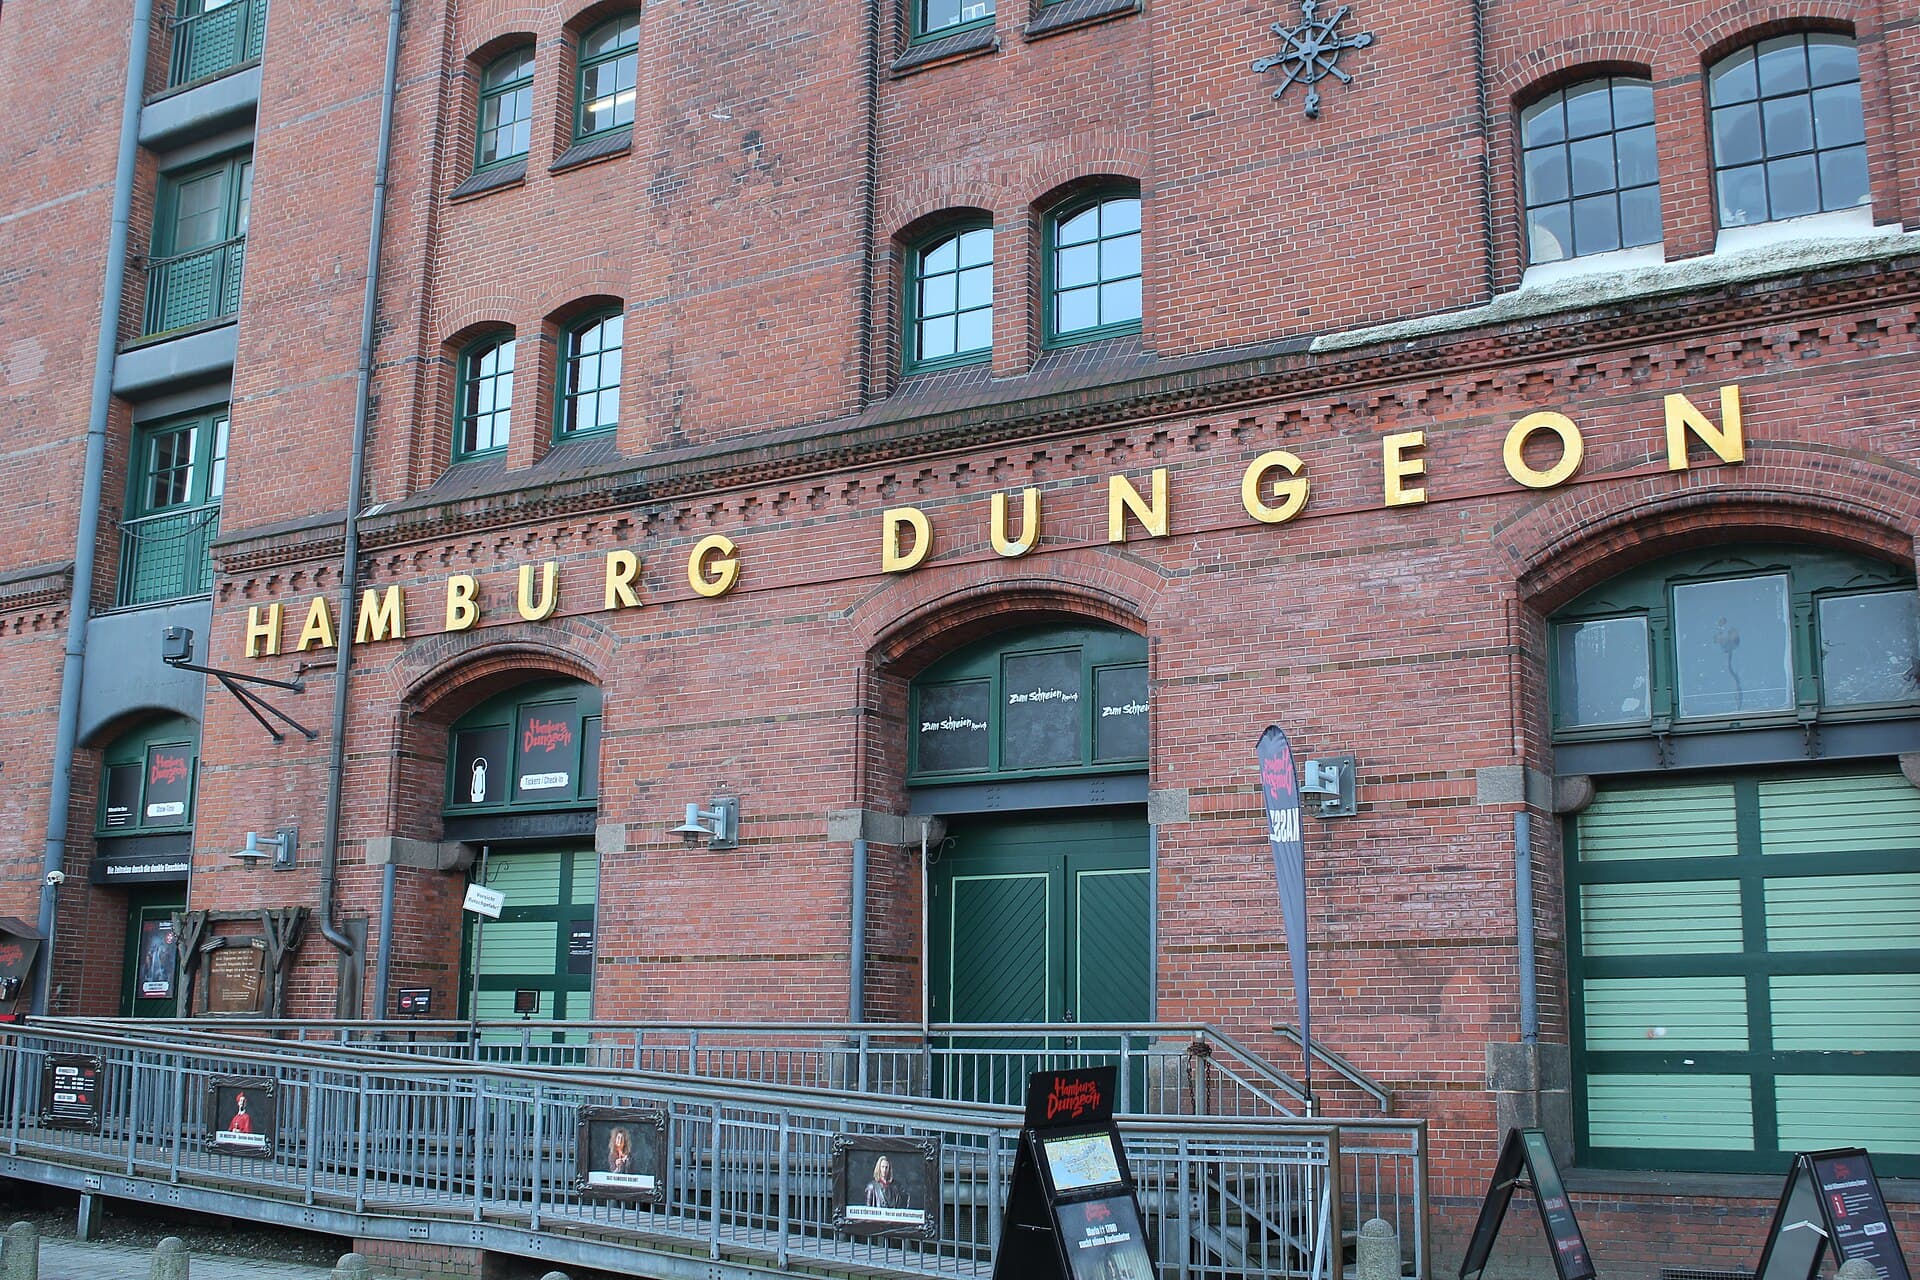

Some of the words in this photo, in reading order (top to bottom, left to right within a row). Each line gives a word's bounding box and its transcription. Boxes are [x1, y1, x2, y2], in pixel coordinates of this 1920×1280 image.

[246, 534, 741, 659] HAMBURG
[882, 384, 1746, 574] DUNGEON
[1009, 693, 1028, 704] Zum
[1029, 687, 1062, 703] Schreien
[1102, 706, 1122, 717] Zum
[1122, 699, 1149, 716] Schrei
[921, 722, 940, 733] Zum
[940, 715, 972, 731] Schreien
[1054, 1077, 1096, 1097] Hamburg
[1047, 1093, 1100, 1120] Dungeon
